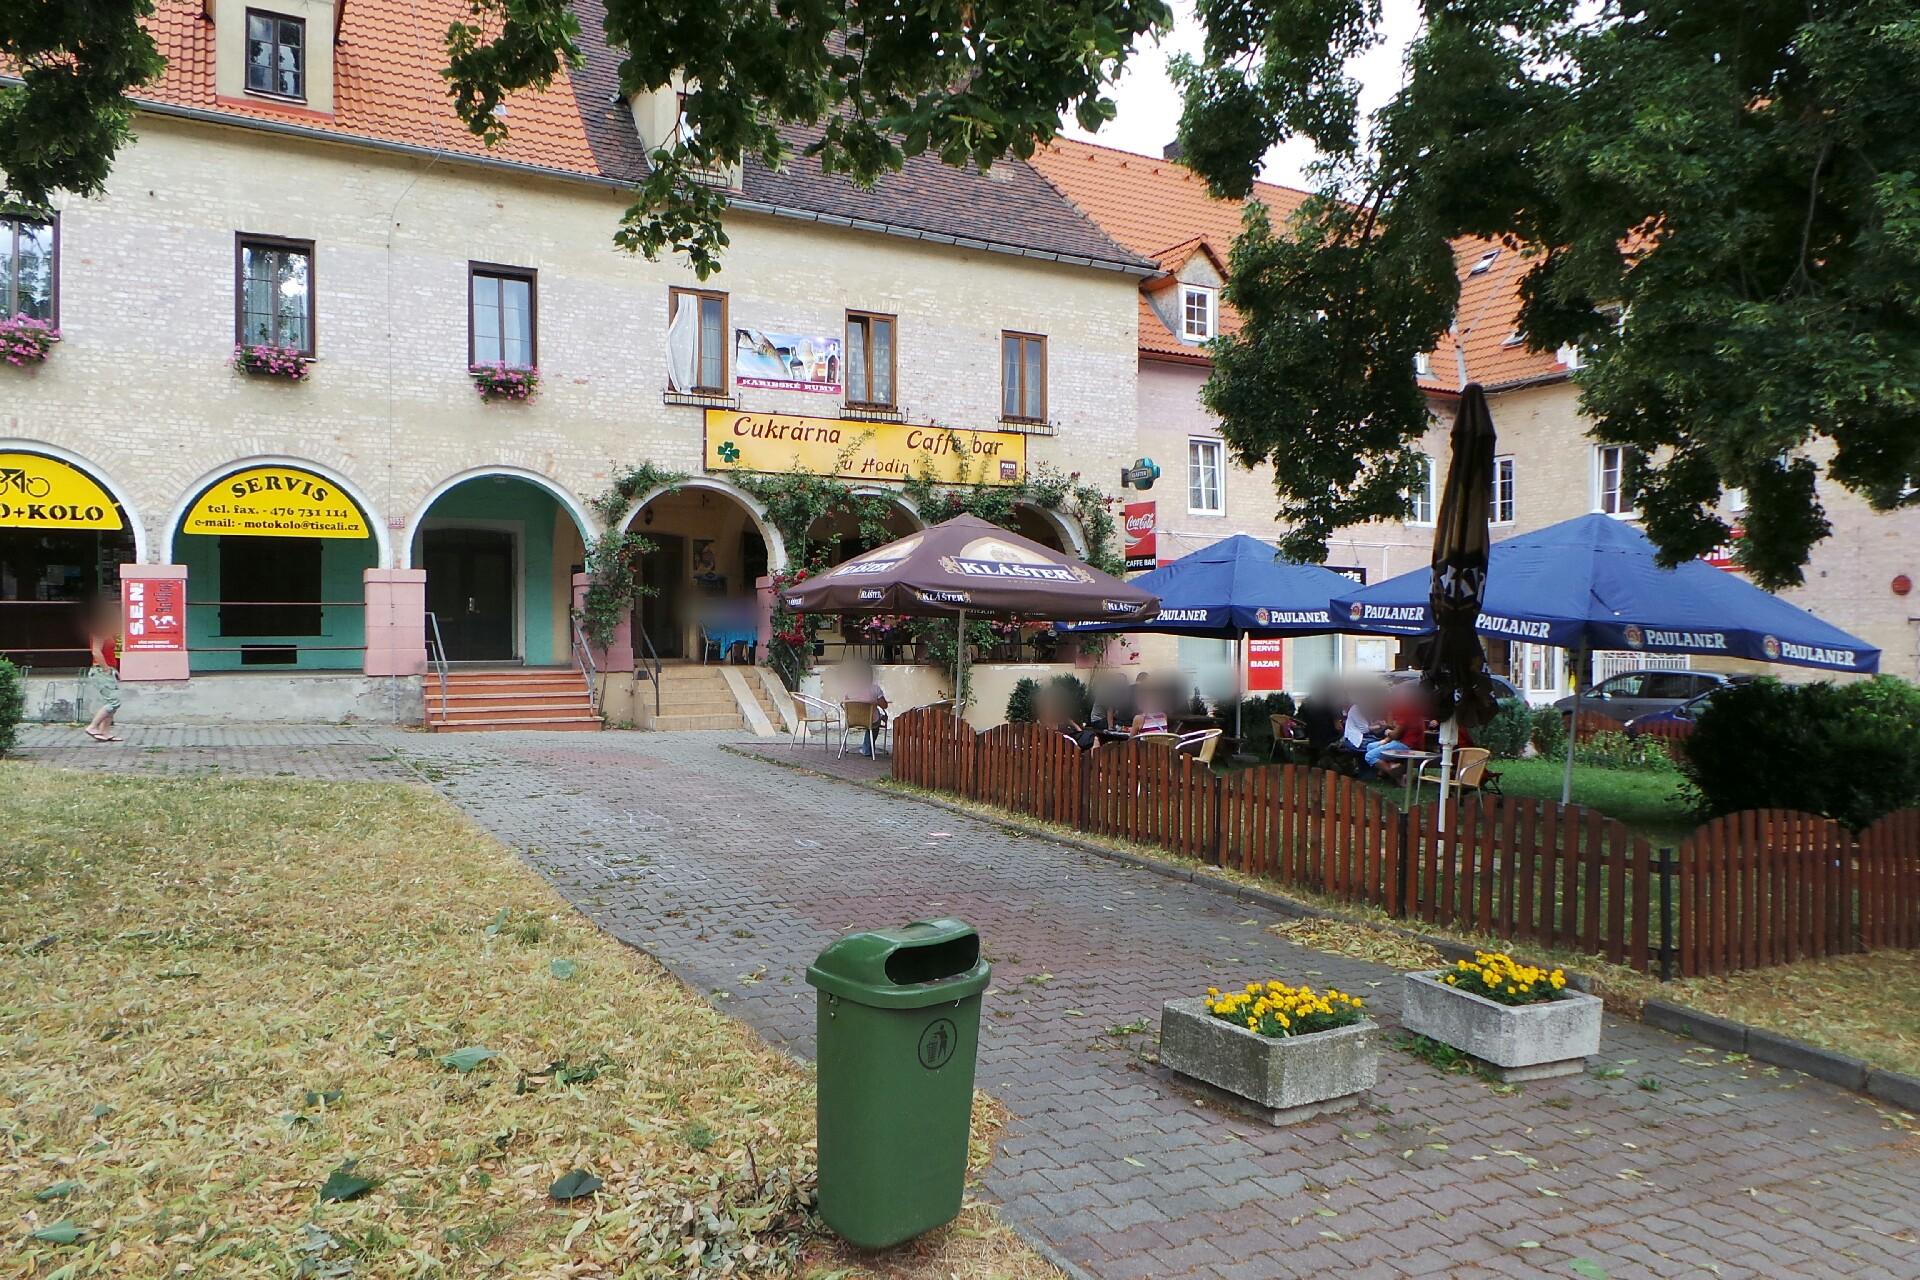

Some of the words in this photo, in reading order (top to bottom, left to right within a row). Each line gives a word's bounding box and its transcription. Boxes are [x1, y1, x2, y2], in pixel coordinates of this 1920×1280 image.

[804, 384, 835, 392] RUMY
[733, 416, 841, 443] Cukrárna
[906, 430, 961, 455] Caffe
[971, 434, 1004, 455] bar
[231, 476, 329, 502] SERVIS
[207, 504, 231, 514] tel.
[233, 505, 260, 515] fax.
[270, 507, 295, 516] 476
[298, 508, 322, 518] 731
[326, 509, 348, 519] 114
[194, 518, 236, 528] e-mail:
[244, 520, 360, 531] motokolo@tiscali.cz
[959, 560, 1076, 581] KLÁŠTER
[1126, 559, 1143, 568] CAFFE
[1144, 558, 1156, 566] BAR
[921, 592, 966, 602] KLÁŠTER
[1156, 609, 1208, 621] PAULANER
[1271, 611, 1331, 623] PAULANER
[1363, 604, 1424, 621] PAULANER
[1474, 613, 1551, 638] PAULANER
[1645, 629, 1727, 649] PAULANER
[1782, 641, 1856, 666] PAULANER
[1250, 660, 1280, 668] BAZAR
